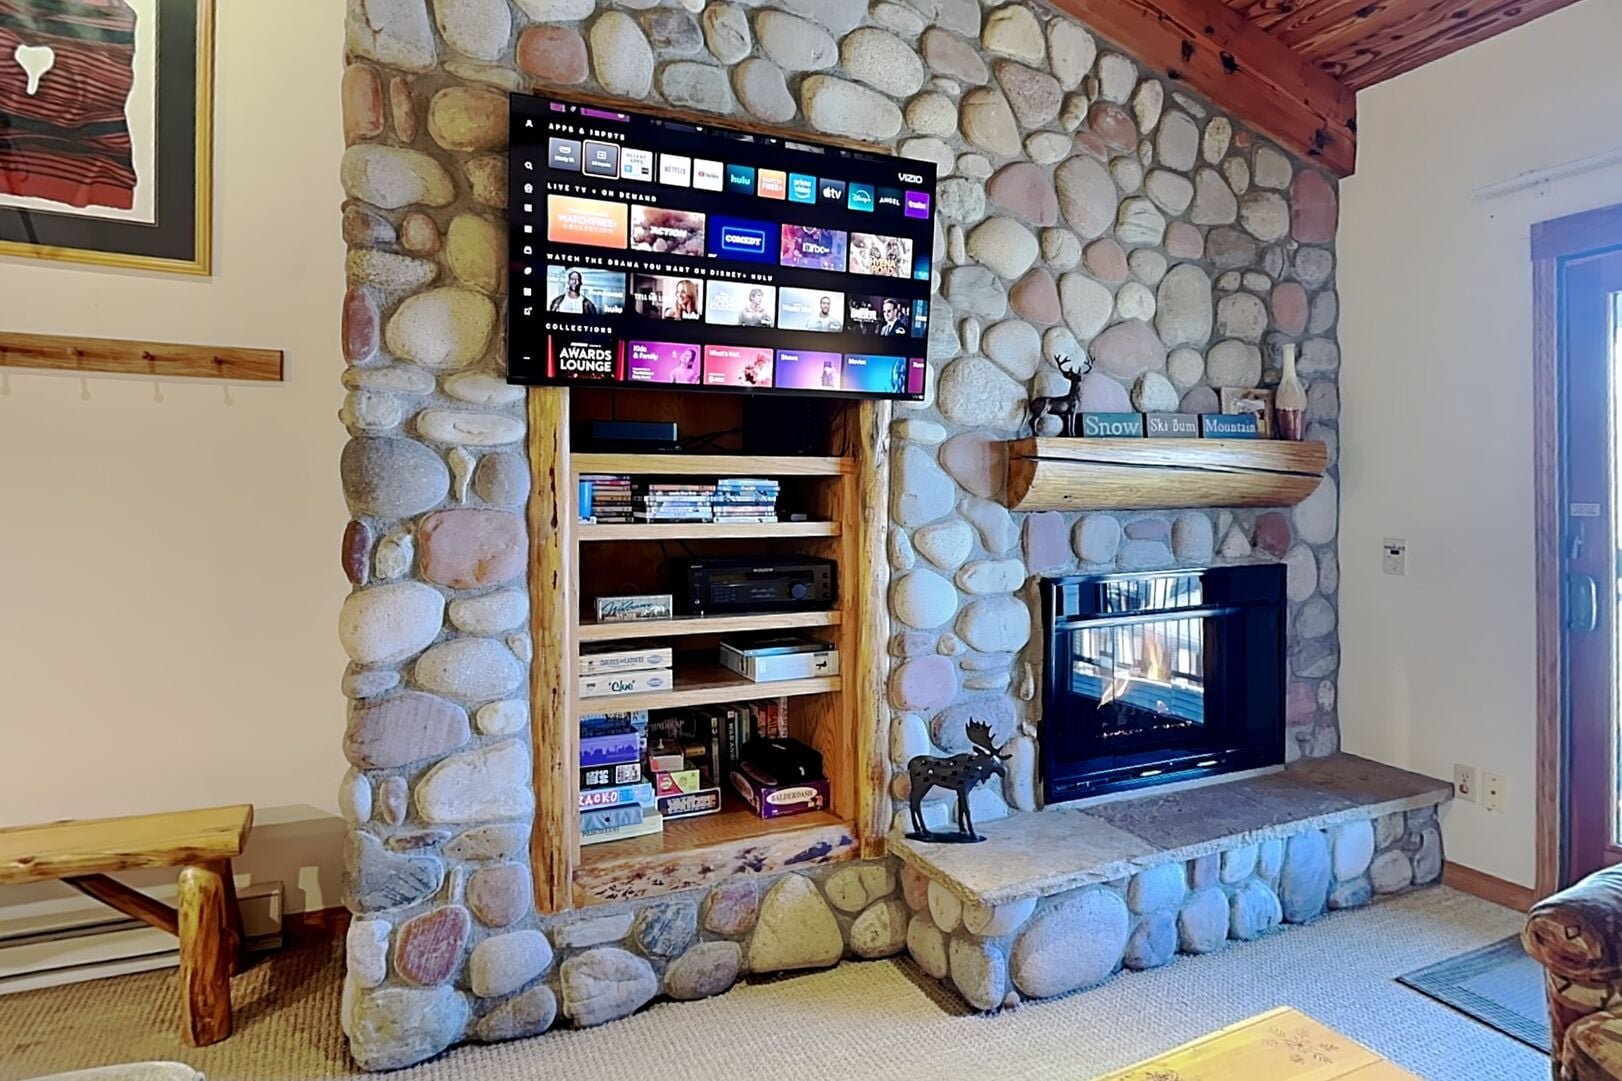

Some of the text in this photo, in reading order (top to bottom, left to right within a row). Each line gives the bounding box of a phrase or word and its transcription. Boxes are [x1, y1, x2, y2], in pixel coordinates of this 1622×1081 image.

[548, 122, 574, 133] APPS
[589, 129, 625, 141] INPUTS
[664, 165, 687, 175] NETFLIX
[730, 173, 751, 185] hulu
[898, 172, 923, 184] VIZIO
[547, 182, 570, 192] LIVE
[575, 186, 587, 194] TV
[601, 189, 614, 197] ON
[619, 192, 657, 203] DEMAND
[879, 197, 901, 206] ANGEL
[650, 225, 688, 238] ACTION
[725, 234, 762, 246] COMEDY
[546, 253, 580, 263] WATCH
[585, 256, 603, 265] THE
[607, 258, 639, 269] DRAMA
[644, 262, 661, 271] YOU
[665, 264, 690, 274] WANT
[694, 267, 706, 275] ON
[751, 273, 773, 282] HULU
[545, 322, 612, 334] COLLECTIONS
[560, 347, 612, 361] AWARDS
[633, 344, 647, 353] Kids
[640, 353, 659, 362] Family
[848, 358, 867, 366] Movies
[560, 358, 612, 372] LOUNGE
[1085, 416, 1140, 436] Snow
[1150, 418, 1196, 433] Ski Bum
[1205, 418, 1257, 433] Mountain
